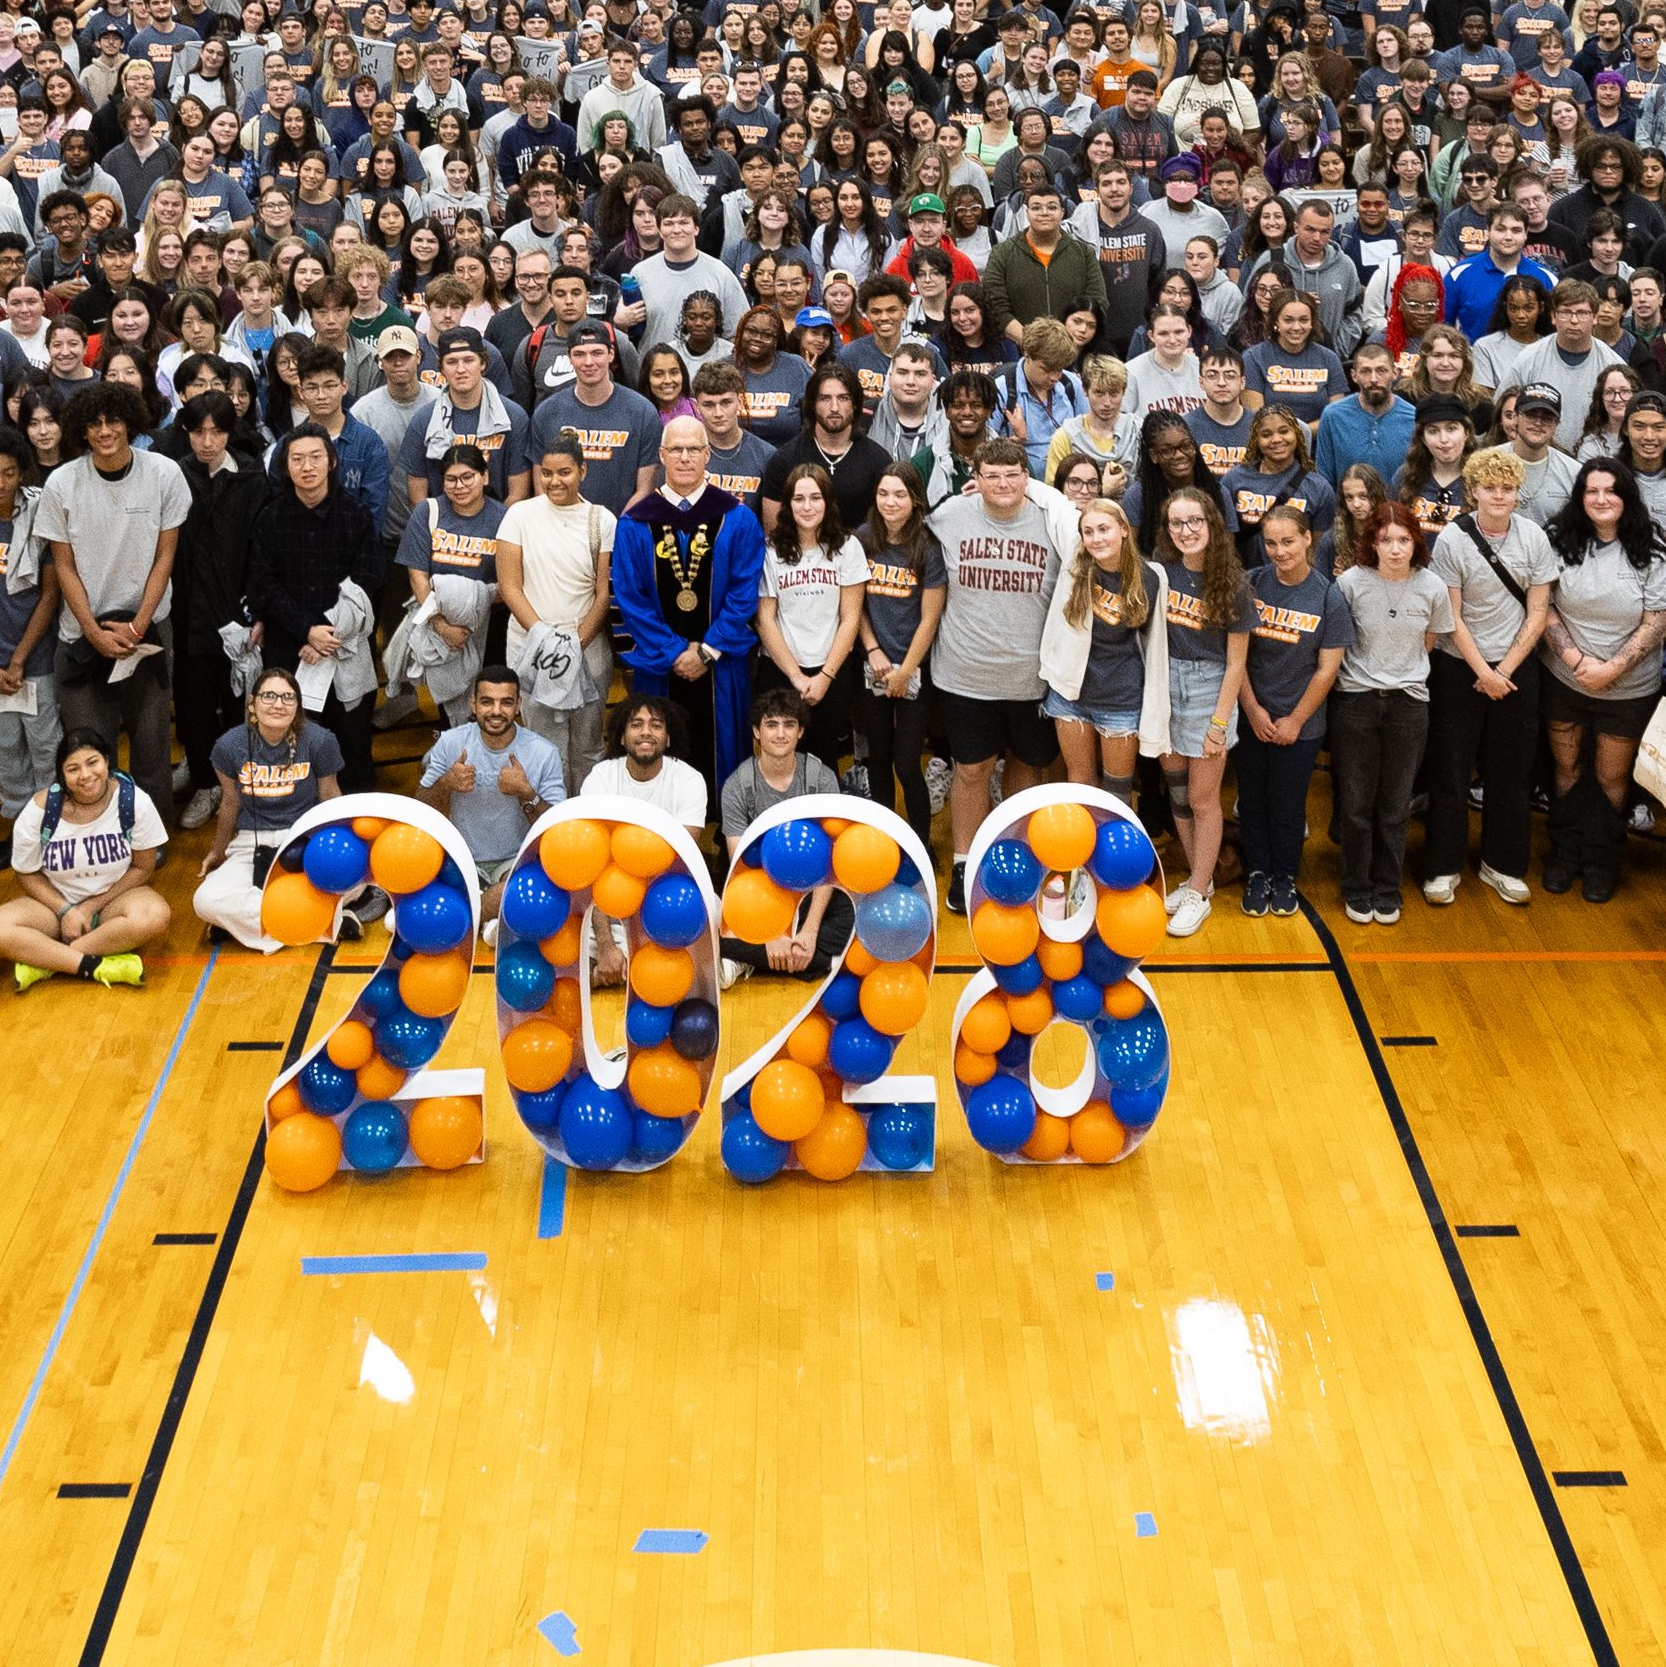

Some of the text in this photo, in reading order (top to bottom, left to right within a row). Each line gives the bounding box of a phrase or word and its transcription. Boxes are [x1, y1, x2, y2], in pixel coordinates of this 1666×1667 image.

[1122, 233, 1148, 248] STATE
[1266, 365, 1329, 384] SALEM
[959, 537, 1048, 570] SALEM STATE
[777, 568, 839, 590] SALEM STATE
[958, 565, 1044, 594] UNIVERSITY
[83, 832, 131, 866] YORK
[261, 782, 1171, 1192] 2028
